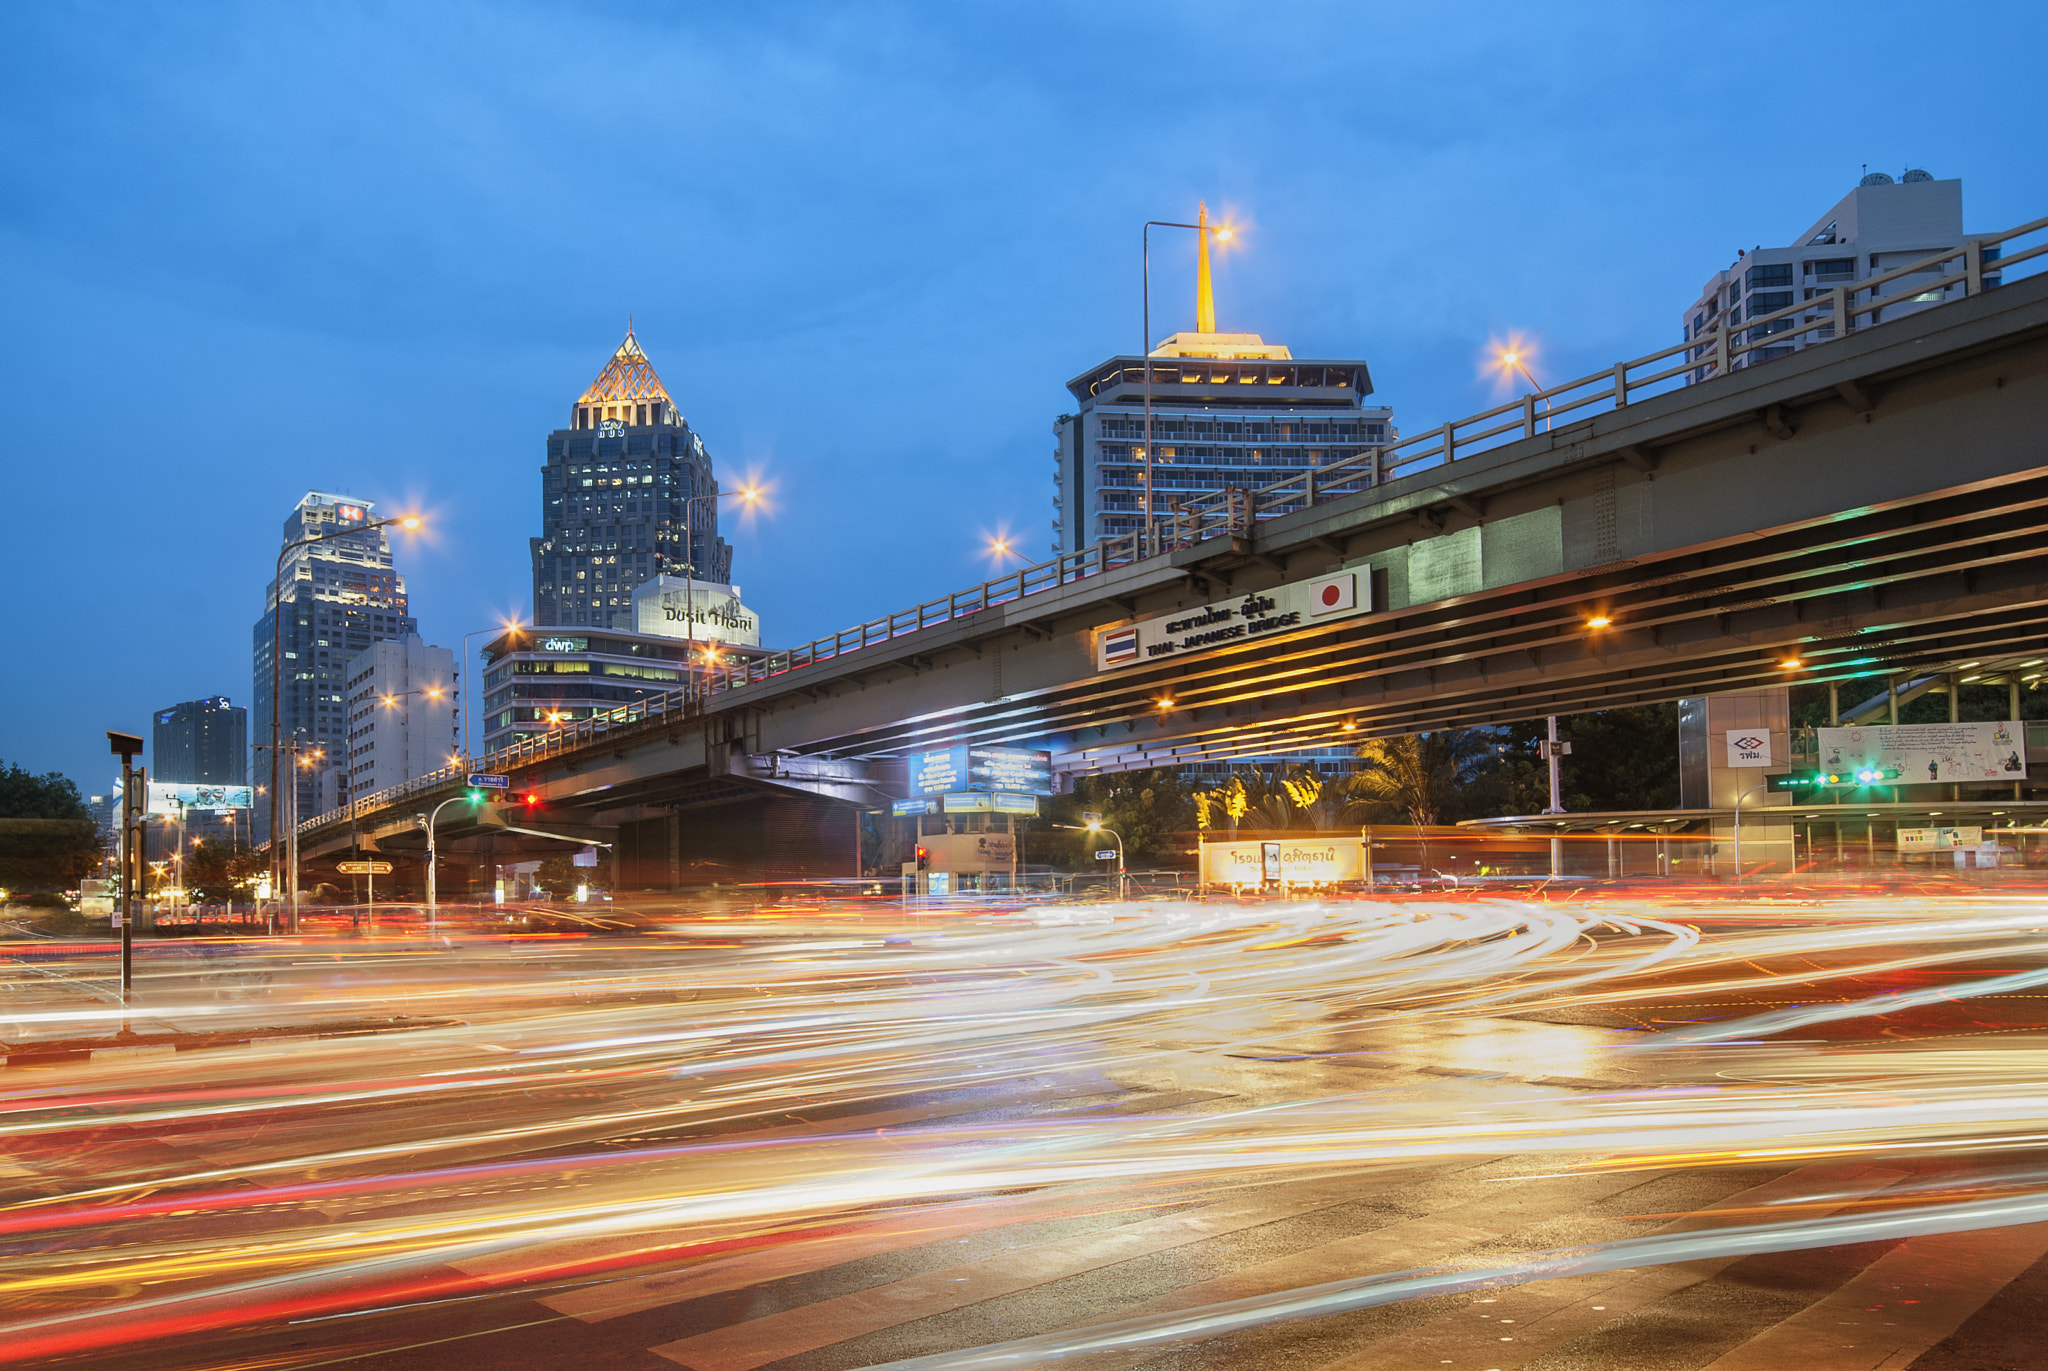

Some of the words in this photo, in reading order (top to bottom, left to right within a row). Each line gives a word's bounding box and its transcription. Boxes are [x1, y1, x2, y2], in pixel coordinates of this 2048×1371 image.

[662, 606, 706, 625] Dusit
[708, 607, 752, 632] Thani
[1248, 611, 1301, 634] BRIDGE
[544, 637, 574, 653] dwp
[1739, 751, 1763, 760] รฟม.
